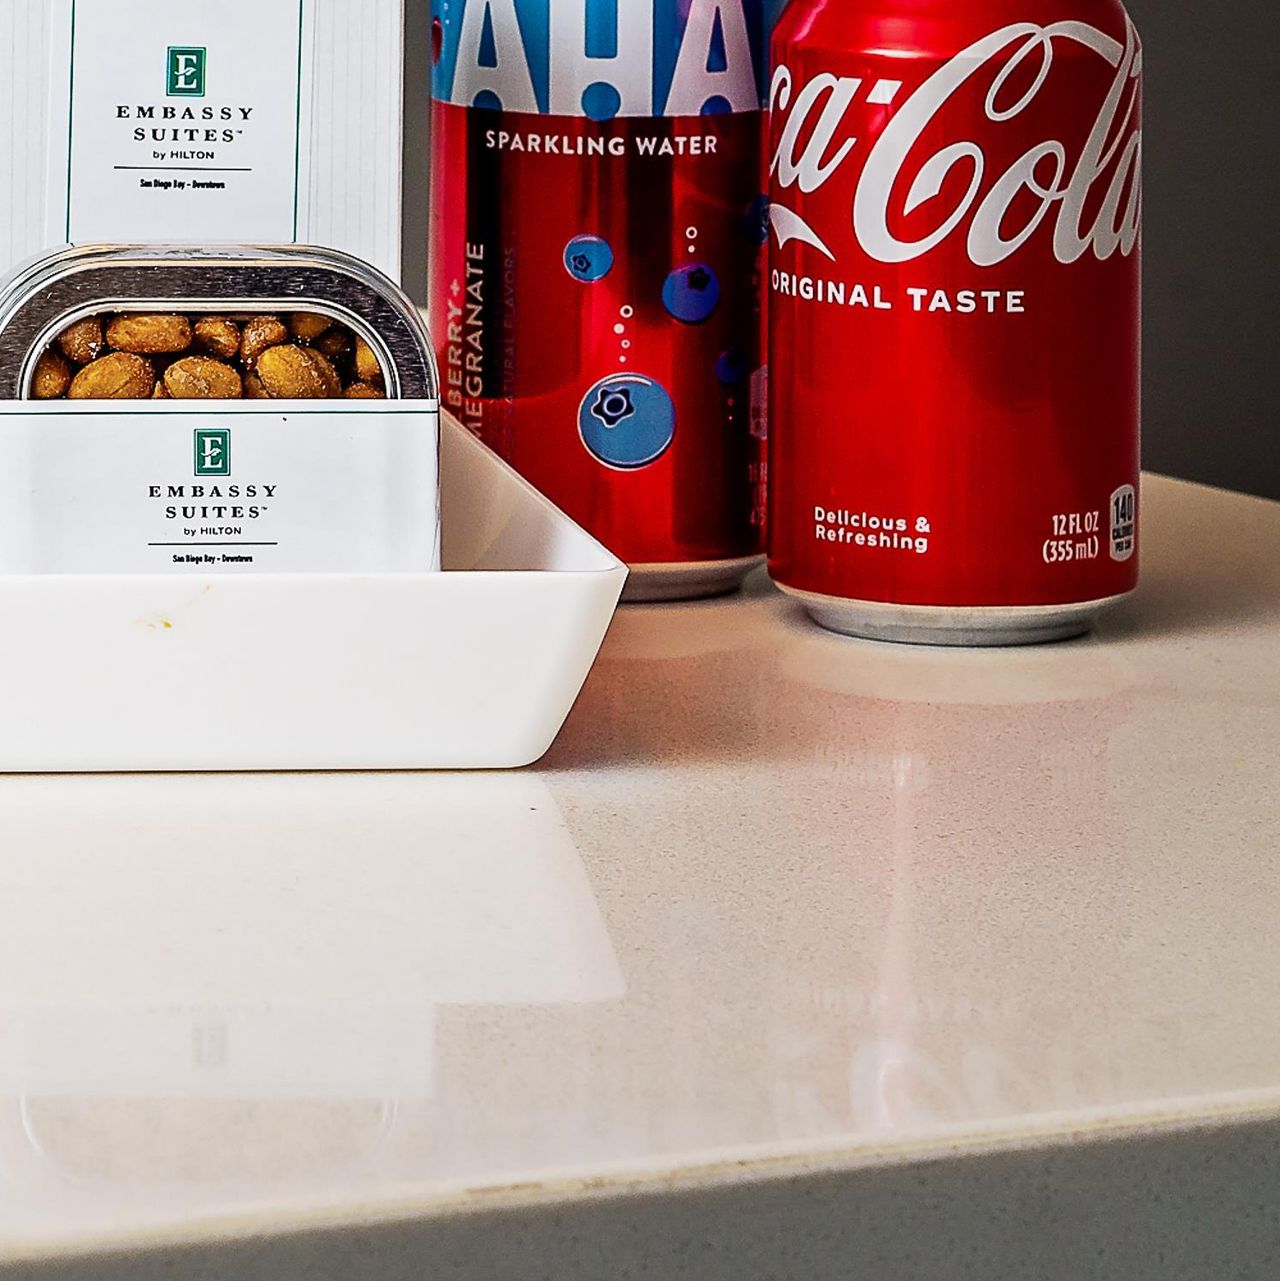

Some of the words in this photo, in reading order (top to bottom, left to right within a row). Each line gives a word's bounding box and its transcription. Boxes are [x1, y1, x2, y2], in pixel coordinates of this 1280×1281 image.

[116, 105, 253, 121] EMBASSY
[153, 151, 166, 161] by
[170, 151, 215, 160] HILTON
[486, 130, 626, 156] SPARKLING
[636, 135, 718, 157] WATER
[771, 269, 892, 310] ORIGINAL
[906, 287, 1025, 313] TASTE
[149, 485, 277, 498] EMBASSY
[815, 506, 907, 531] Delicious
[915, 516, 930, 533] &
[1114, 492, 1133, 525] 140
[183, 527, 197, 537] by
[200, 526, 242, 535] HILTON
[1052, 514, 1067, 536] 12
[1069, 513, 1083, 534] FL
[1084, 510, 1099, 533] OZ
[815, 524, 928, 554] Refreshing
[1042, 539, 1073, 563] (355
[1075, 535, 1099, 560] mL)
